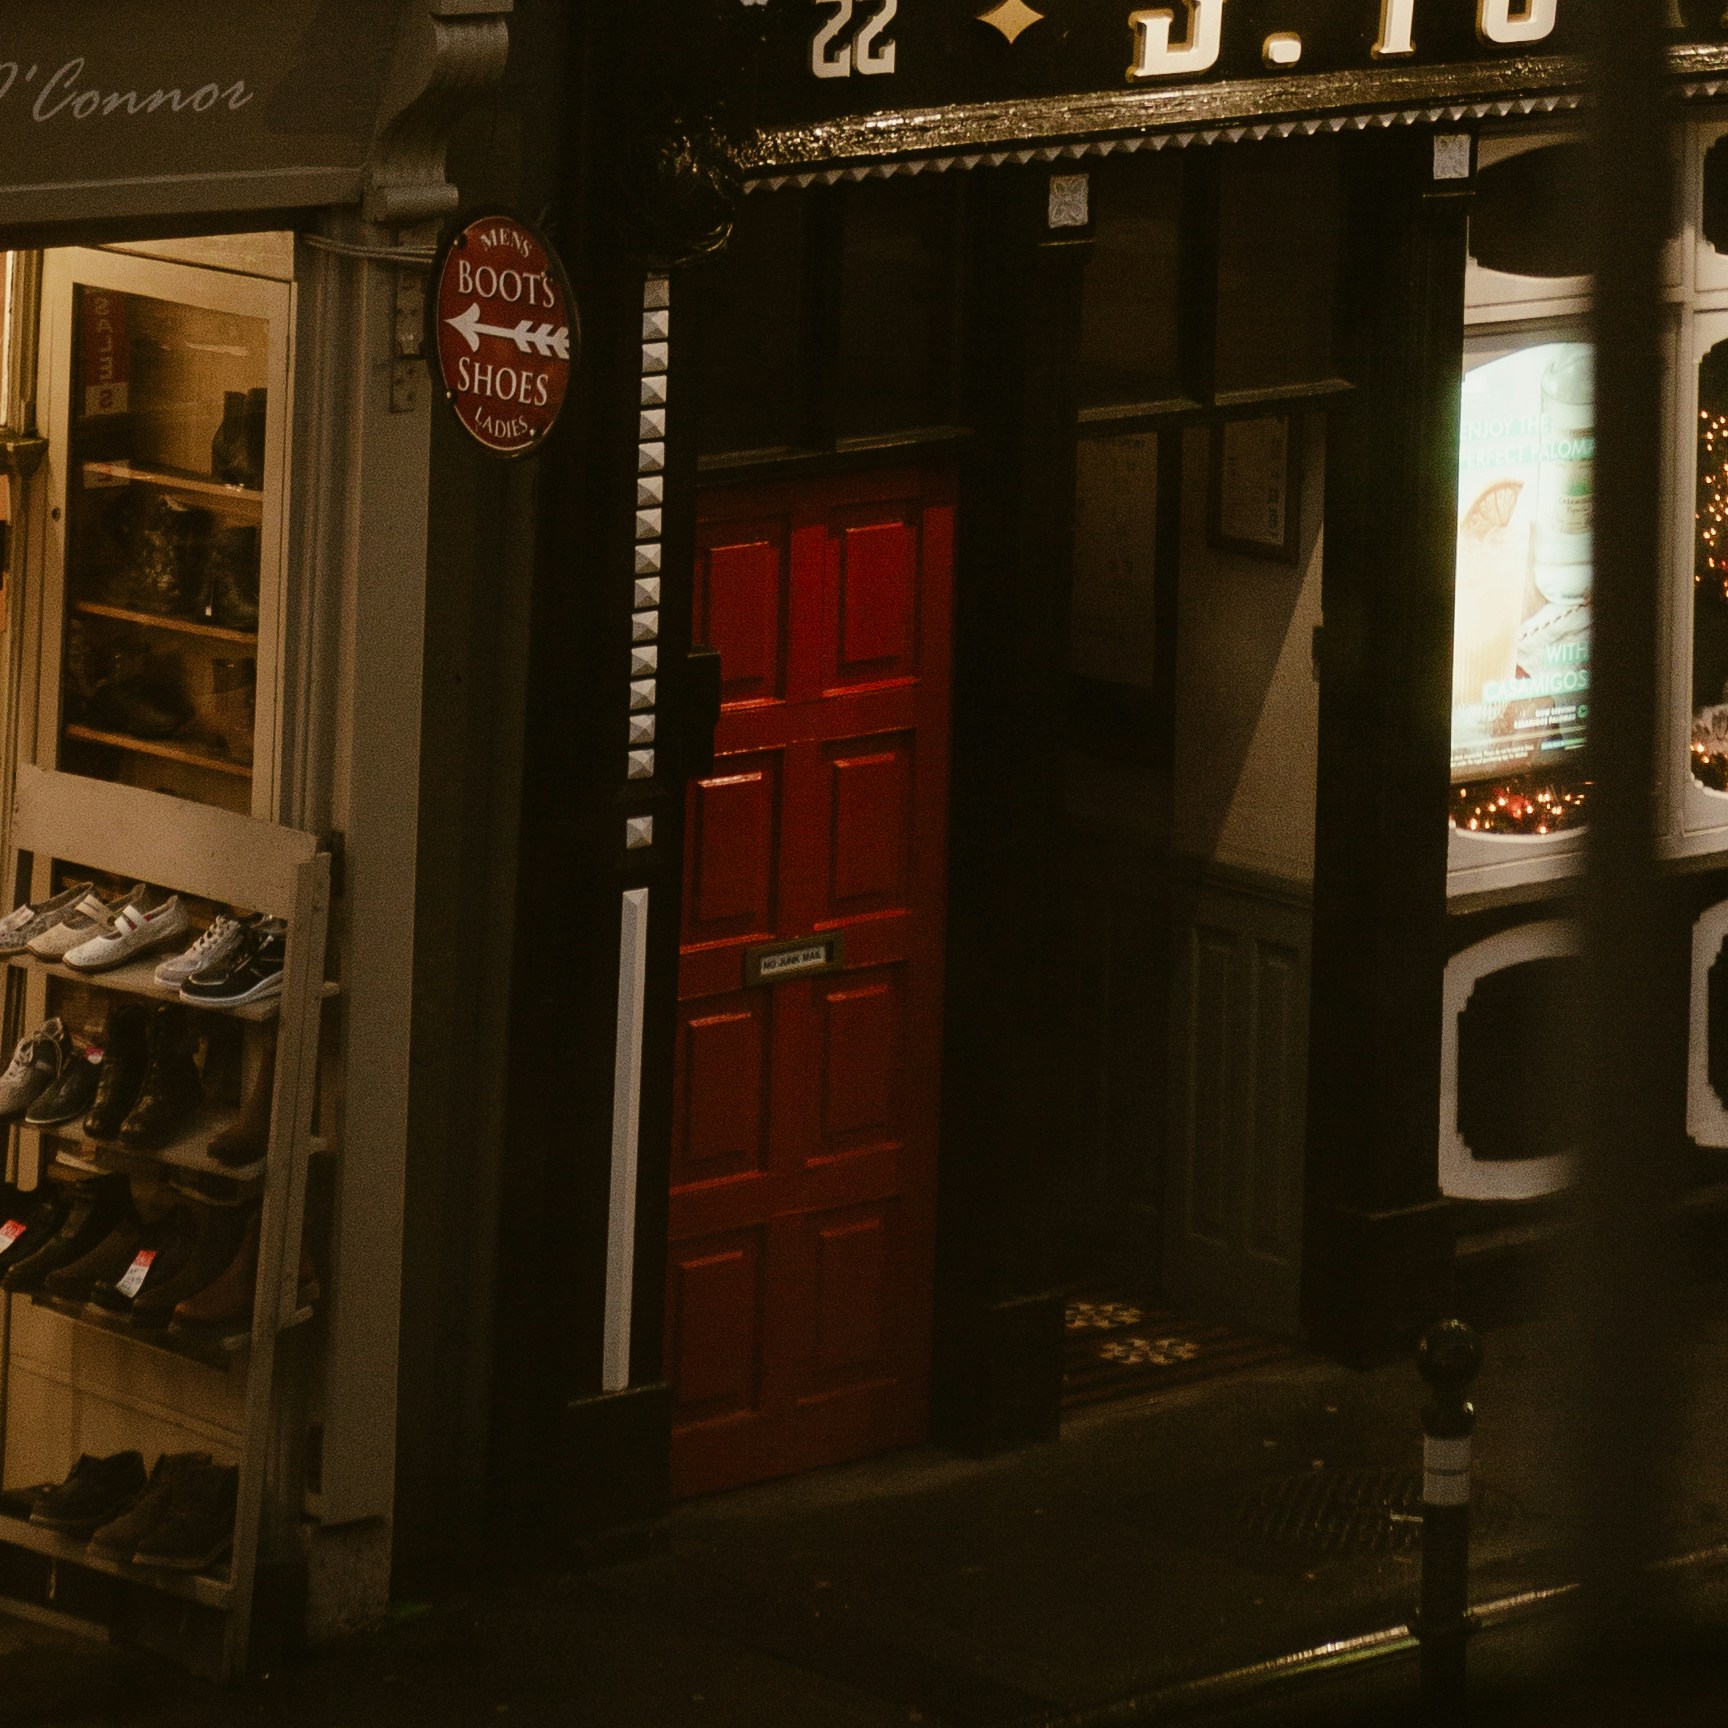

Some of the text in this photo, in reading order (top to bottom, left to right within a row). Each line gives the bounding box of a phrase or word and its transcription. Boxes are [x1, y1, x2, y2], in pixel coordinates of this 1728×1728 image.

[457, 259, 555, 309] BOOTS
[457, 356, 550, 407] SHOES
[474, 405, 529, 439] LADIES
[1516, 415, 1552, 435] THE
[1529, 439, 1592, 463] PALOM
[1483, 669, 1589, 703] CASAMIGOS
